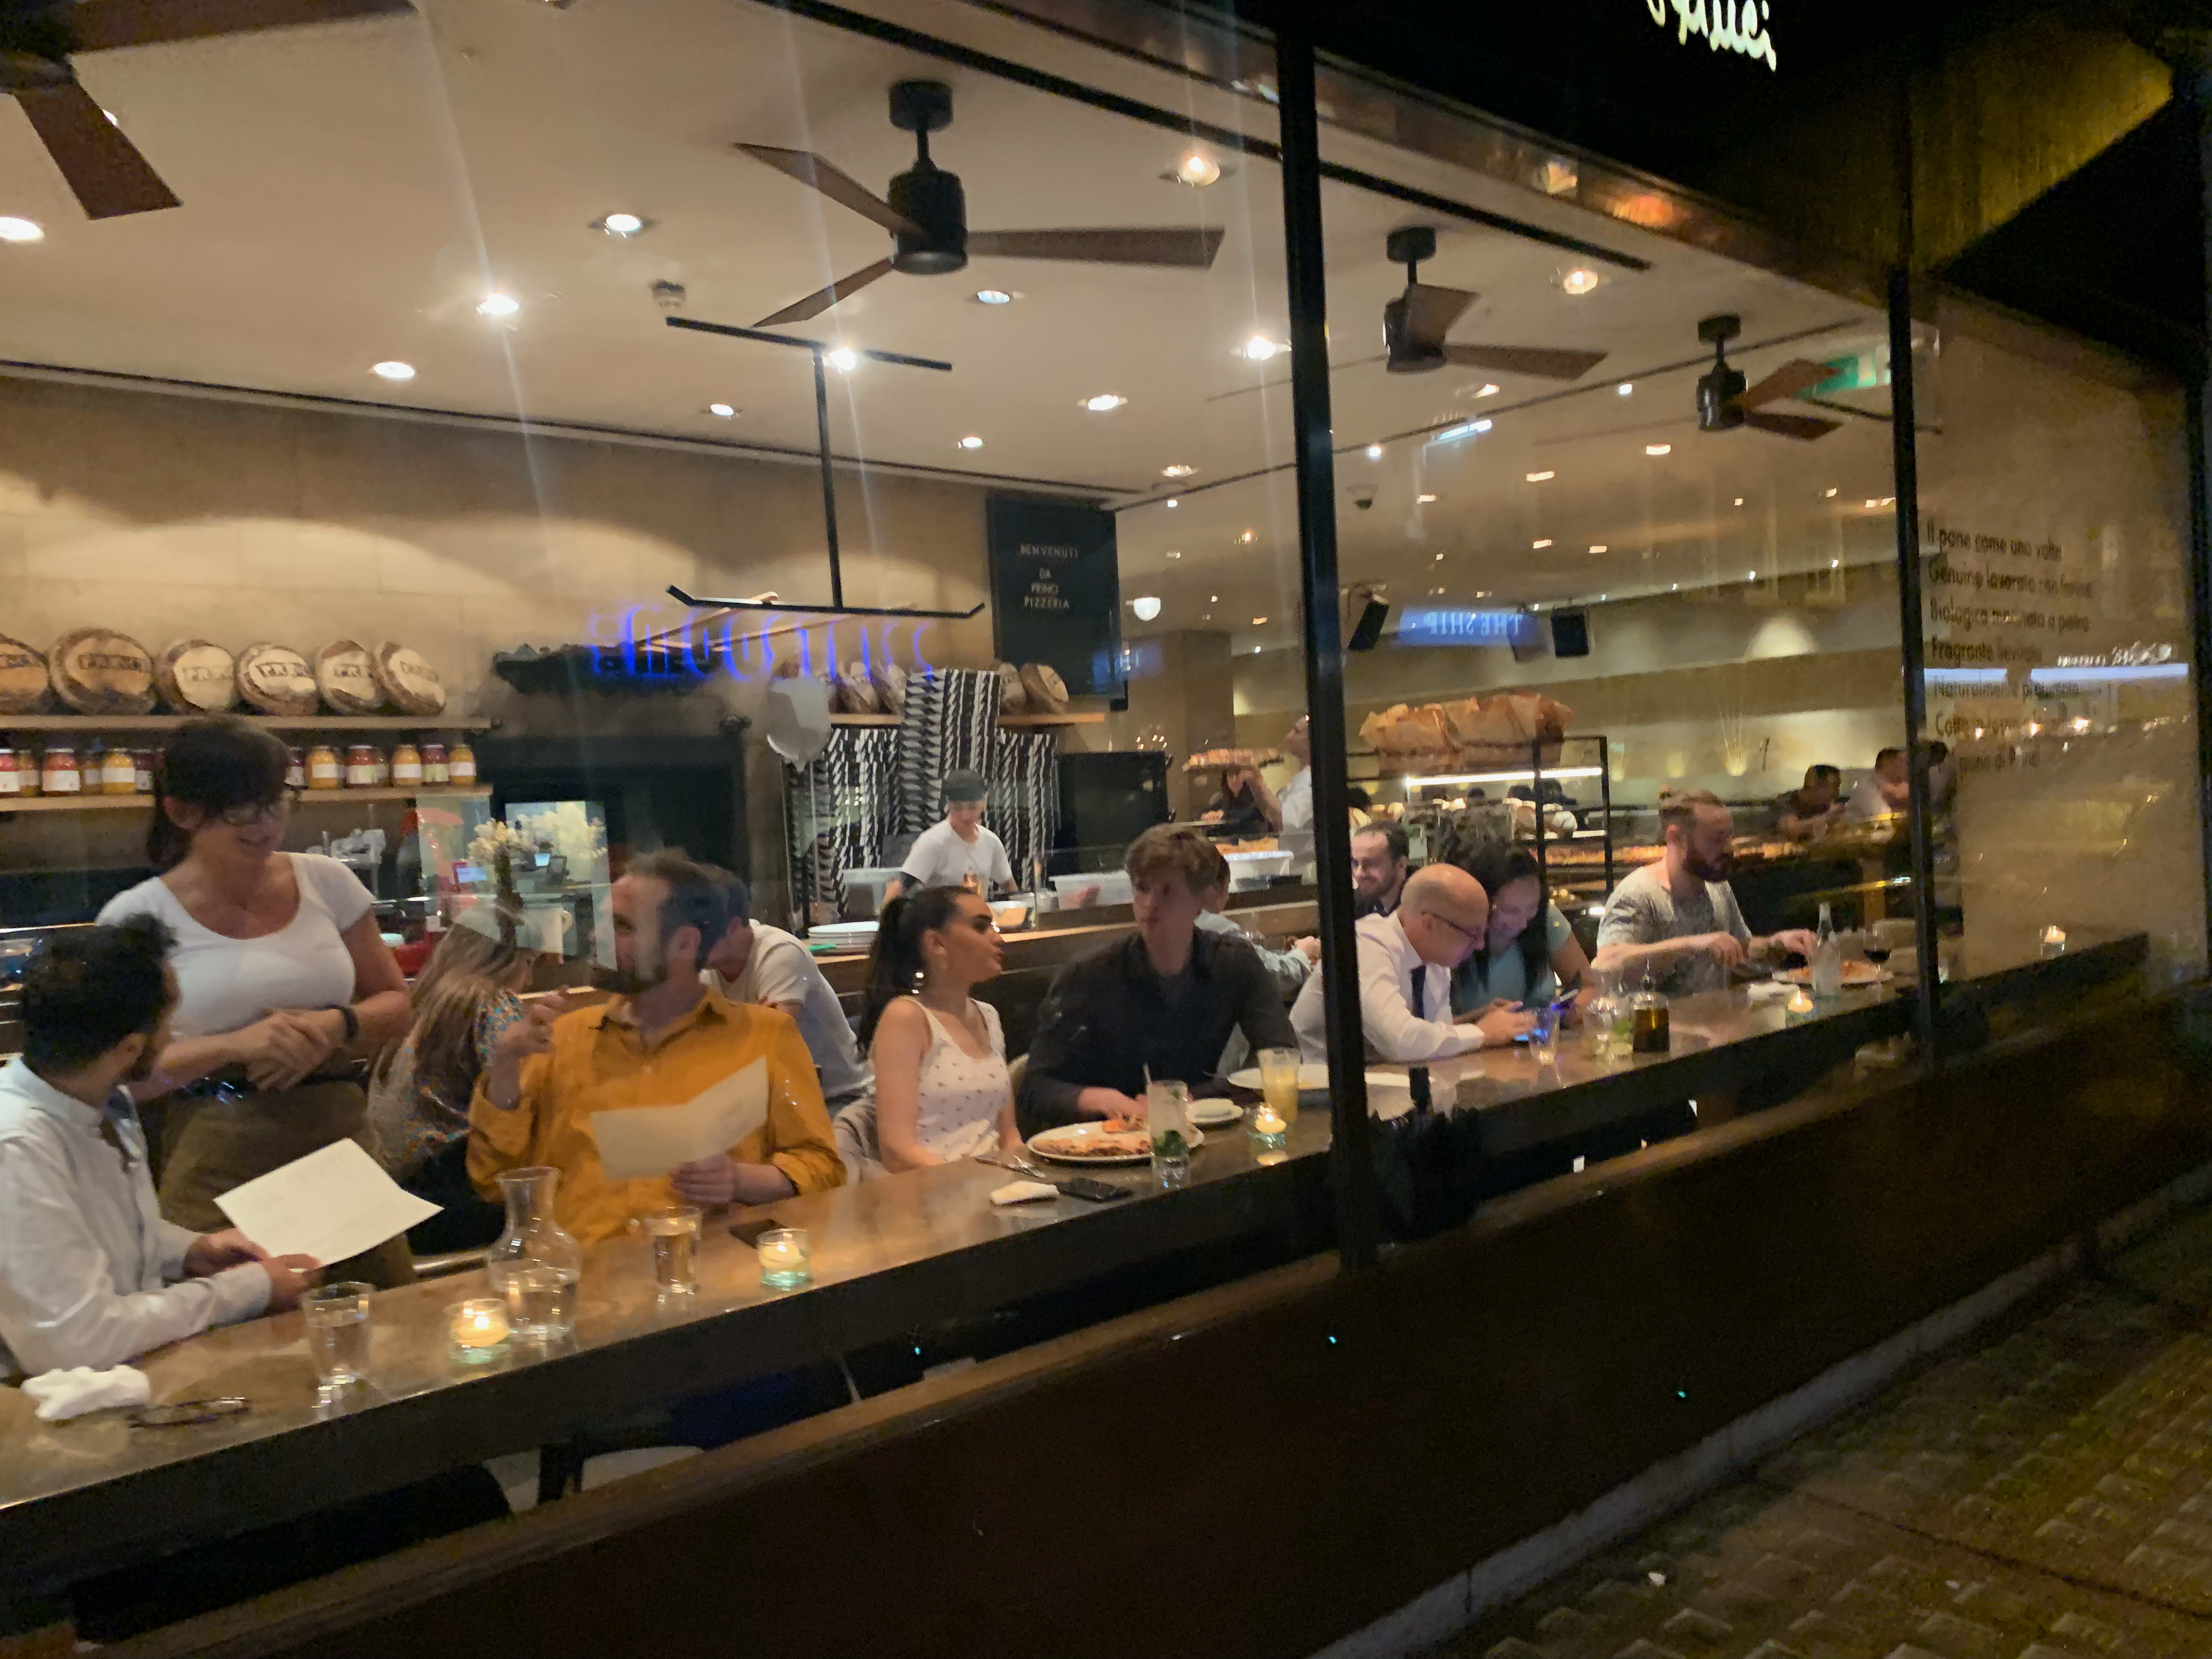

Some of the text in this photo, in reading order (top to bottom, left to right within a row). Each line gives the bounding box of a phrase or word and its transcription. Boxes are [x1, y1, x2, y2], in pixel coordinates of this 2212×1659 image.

[1020, 543, 1078, 558] BENVENUTI
[1039, 567, 1052, 579] DA
[1024, 596, 1070, 610] PIZZERIA
